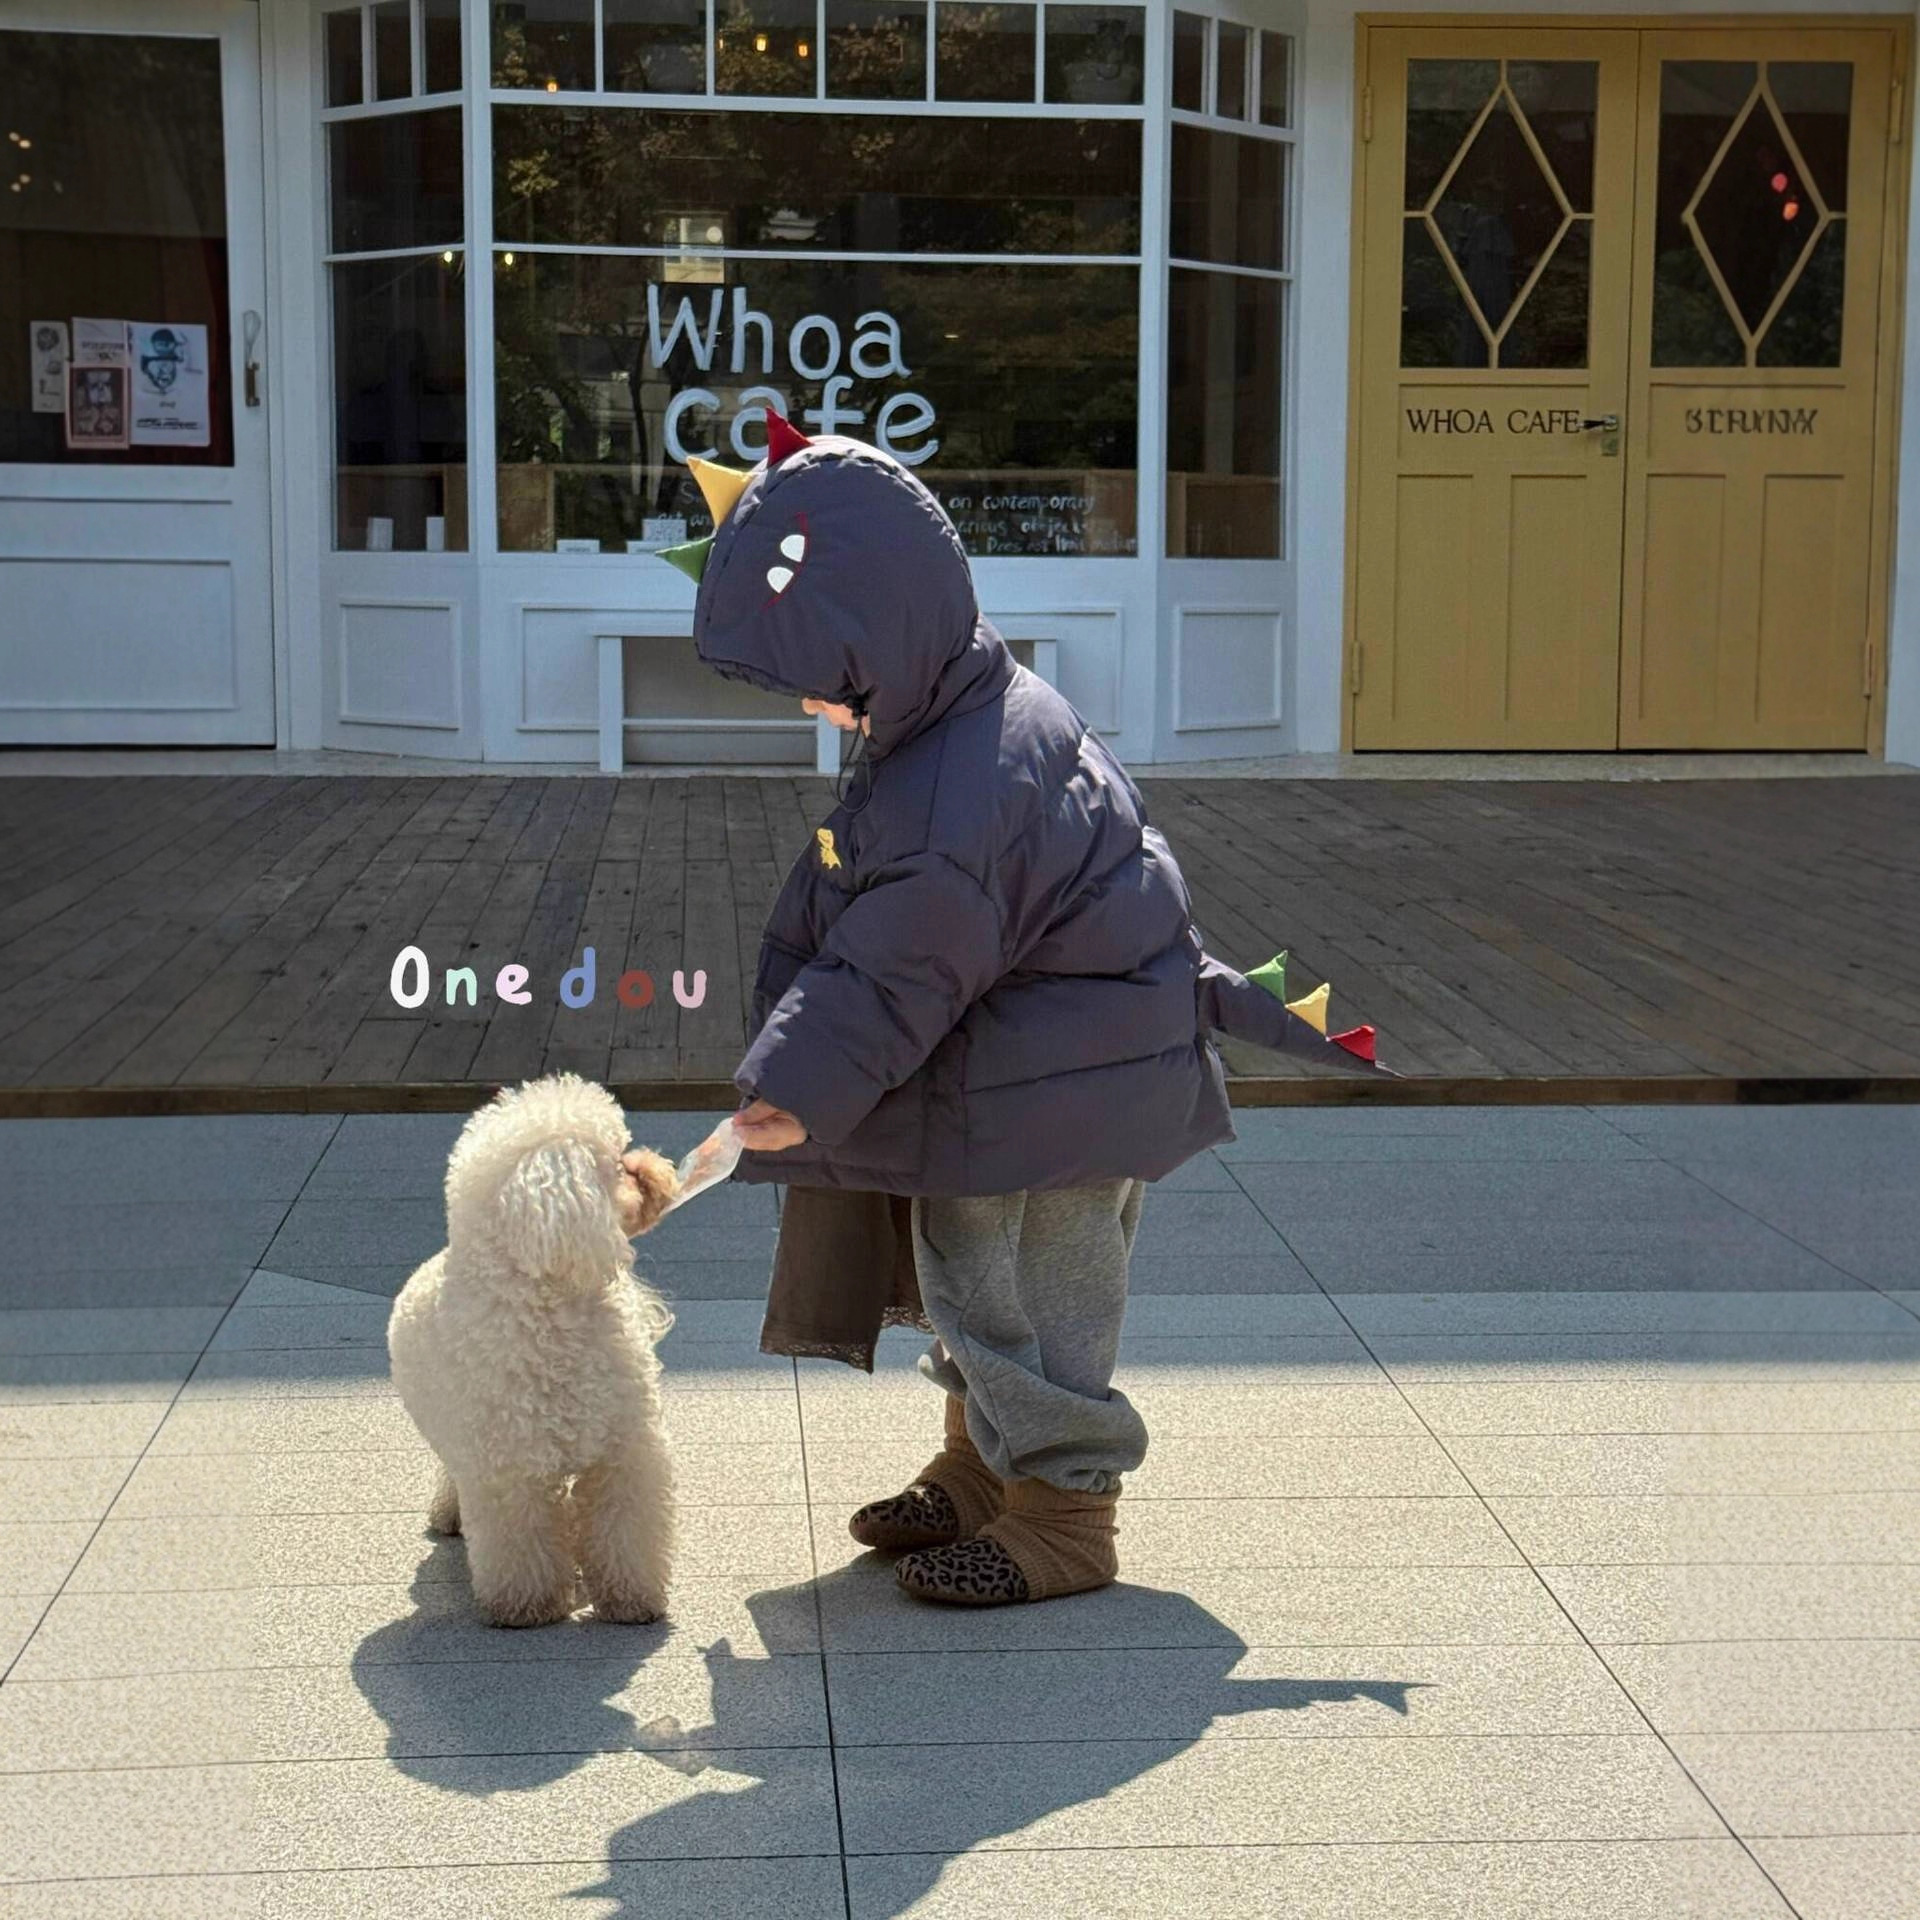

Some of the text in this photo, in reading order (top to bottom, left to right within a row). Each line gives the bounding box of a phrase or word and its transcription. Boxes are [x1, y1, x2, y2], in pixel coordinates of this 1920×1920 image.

[647, 284, 912, 380] Whoa
[664, 376, 939, 466] cafe
[1406, 409, 1581, 434] WHOA CAFE
[948, 496, 972, 509] on
[982, 495, 1095, 515] contemporary
[956, 519, 1008, 536] arious
